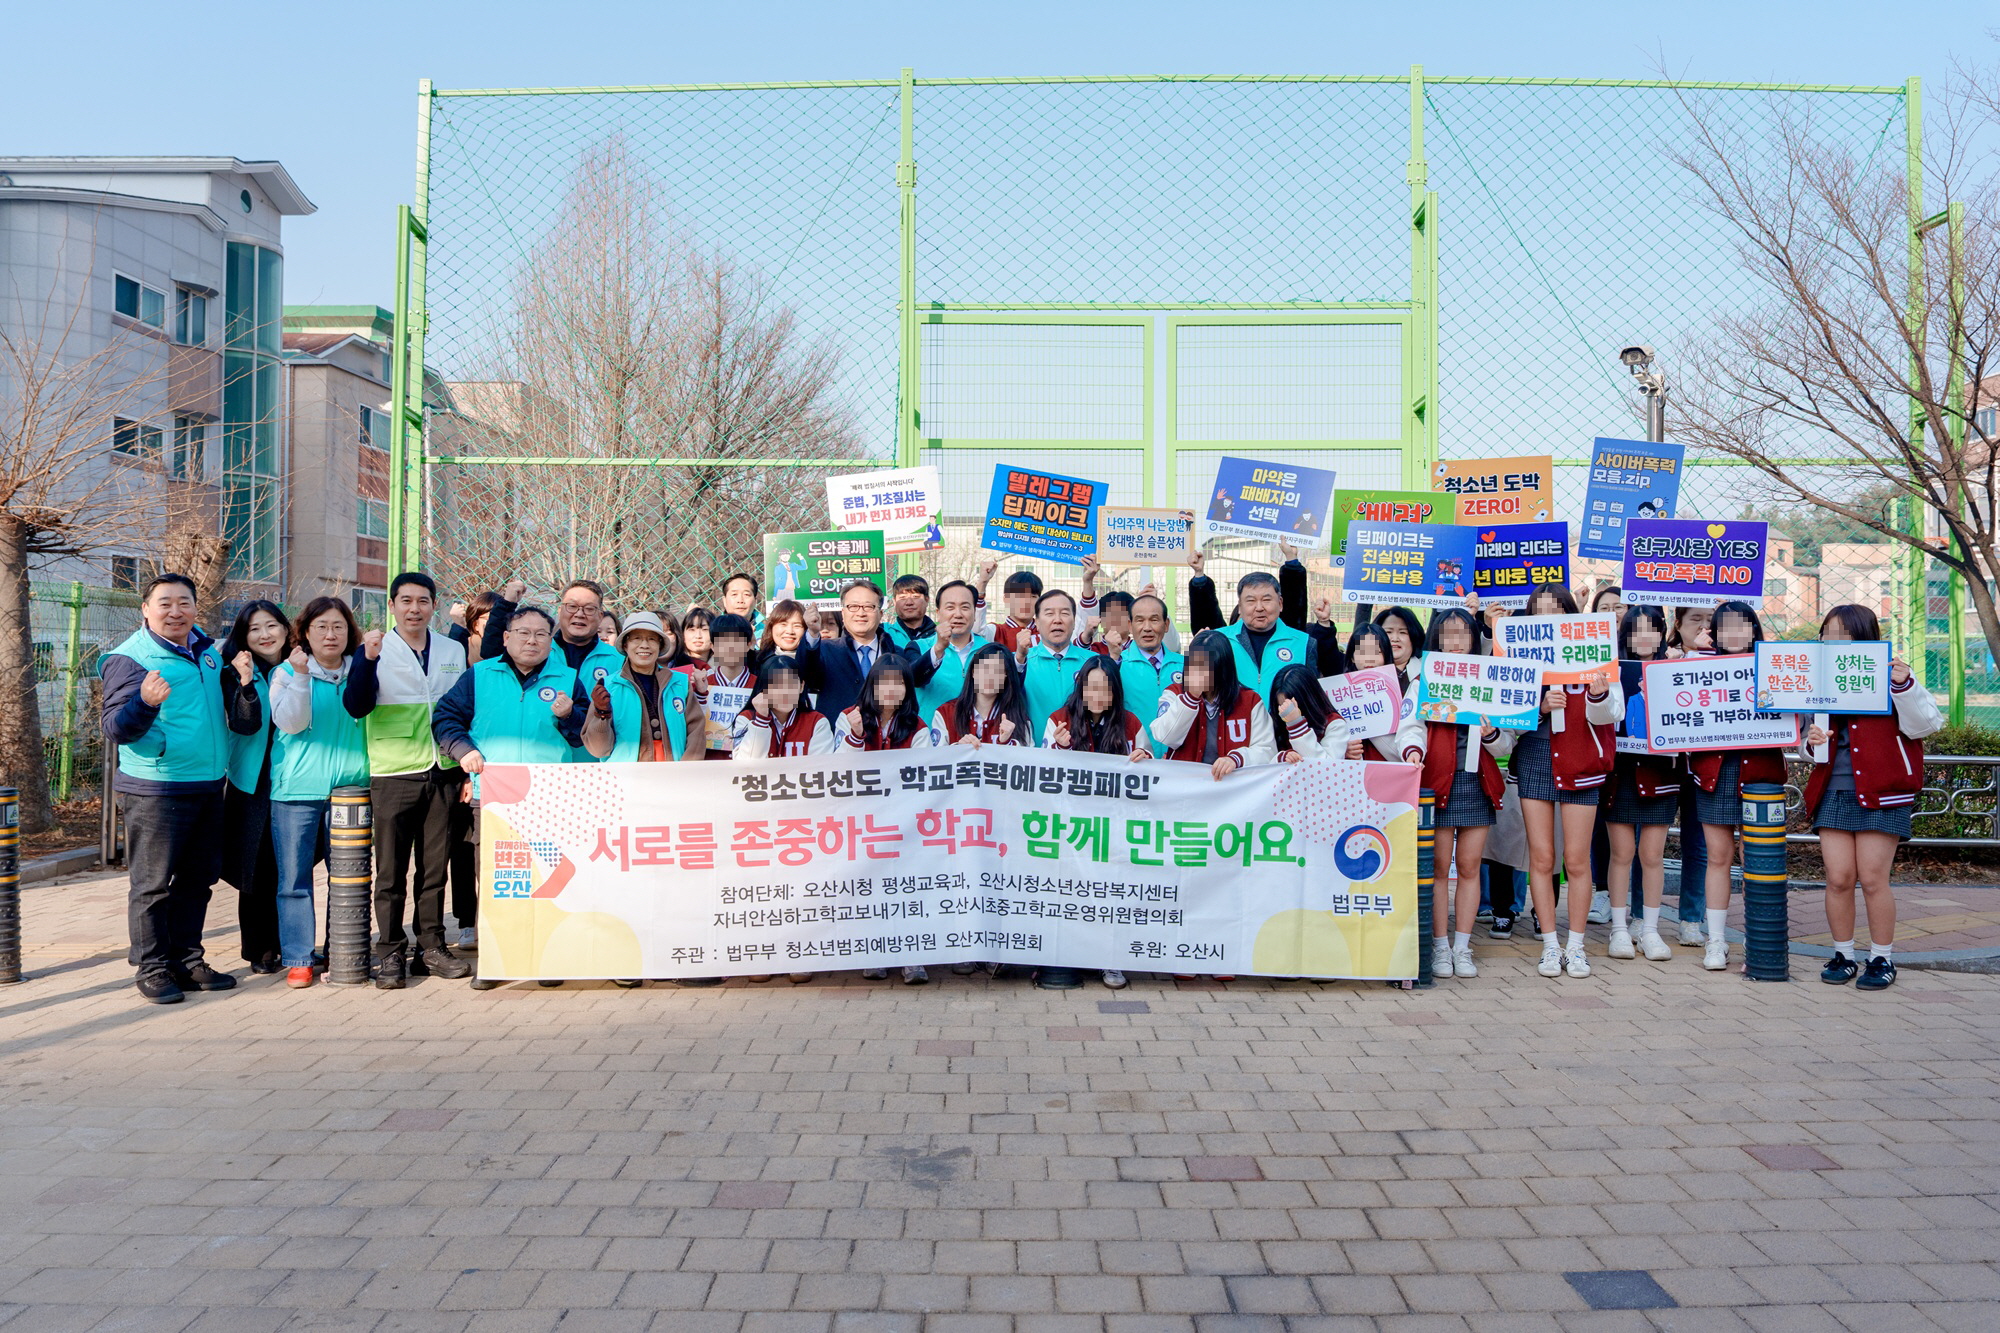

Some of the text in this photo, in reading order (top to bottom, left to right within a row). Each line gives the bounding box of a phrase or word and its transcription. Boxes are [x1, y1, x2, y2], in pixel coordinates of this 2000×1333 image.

[1594, 452, 1676, 474] 사이버폭력
[1008, 470, 1093, 506] 텔레그램
[1252, 468, 1298, 488] 마약은
[1444, 472, 1541, 494] 청소년 도박
[1592, 468, 1652, 489] 모음.zip
[843, 489, 926, 510] 준법, 기초질서는
[1239, 485, 1301, 508] 패배자의
[1463, 497, 1521, 516] ZERO!
[845, 505, 927, 526] 내가 먼저 지켜요
[1002, 494, 1089, 529] 딥페이크
[1248, 505, 1279, 524] 선택
[990, 518, 1094, 544] 소지만 해도 처벌 대상이 됩니다.
[1107, 517, 1186, 532] 나의주먹 나는장난
[1059, 541, 1073, 550] 1377
[1107, 534, 1185, 550] 상대방은 슬픈상처
[1219, 525, 1234, 533] 법무부
[1278, 535, 1314, 546] 산지구위원회
[1356, 530, 1434, 549] 딥페이크는
[808, 540, 869, 556] 도와줄께!
[1362, 548, 1425, 567] 진실왜곡
[1475, 540, 1562, 558] 미래의 리더는
[1632, 536, 1759, 559] 친구사랑 YES
[817, 558, 881, 575] 믿어줄께!
[1360, 567, 1424, 586] 기술남용
[1494, 568, 1528, 585] 바로
[1530, 565, 1564, 584] 당신
[1635, 562, 1752, 585] 학교폭력 NO
[1377, 595, 1426, 605] 청소년범죄예방위원
[1658, 596, 1711, 604] 청소년범죄예방위원
[1505, 621, 1611, 643] 몰아내자 학교폭력
[1561, 644, 1612, 664] 우리학교
[1771, 654, 1810, 671] 폭력은
[1834, 654, 1876, 671] 상처는
[1433, 660, 1536, 684] 학교폭력 예방하여
[1579, 673, 1611, 681] 운천중교
[1672, 670, 1729, 687] 호기심이
[1332, 680, 1386, 703] 넘치는 학교
[1768, 675, 1812, 692] 한순간,
[1834, 675, 1875, 691] 영원히
[1428, 682, 1537, 706] 안전한 학교 만들자
[1698, 689, 1741, 707] 용기로
[710, 711, 738, 722] 꺼져가
[1336, 700, 1384, 721] 력은 NO!
[1661, 712, 1705, 728] 마약을
[1226, 719, 1248, 743] U
[1667, 731, 1793, 745] 법무부 청소년범죄예방위원 오산지구위원회
[732, 761, 1160, 802] '청소년선도, 학교폭력예방캠페인'
[495, 840, 530, 850] 함께하는
[588, 807, 1306, 872] 서로를 존중하는 학교, 함께 만들어요.
[495, 851, 532, 869] 변화
[494, 870, 531, 879] 미래도시
[493, 881, 532, 898] 오산
[720, 871, 1178, 904] 참여단체: 오산시청 평생교육과, 오산시청소년상담복지센터
[713, 896, 1184, 929] 자녀안심하고학교보내기회, 오산시초중고학교운영위원협의회
[1332, 894, 1393, 916] 법무부
[671, 946, 705, 965] 주관
[727, 943, 777, 962] 법무부
[785, 933, 937, 959] 청소년범죄예방위원
[945, 930, 1043, 952] 오산지구위원회
[1128, 940, 1226, 961] 후원: 오산시
